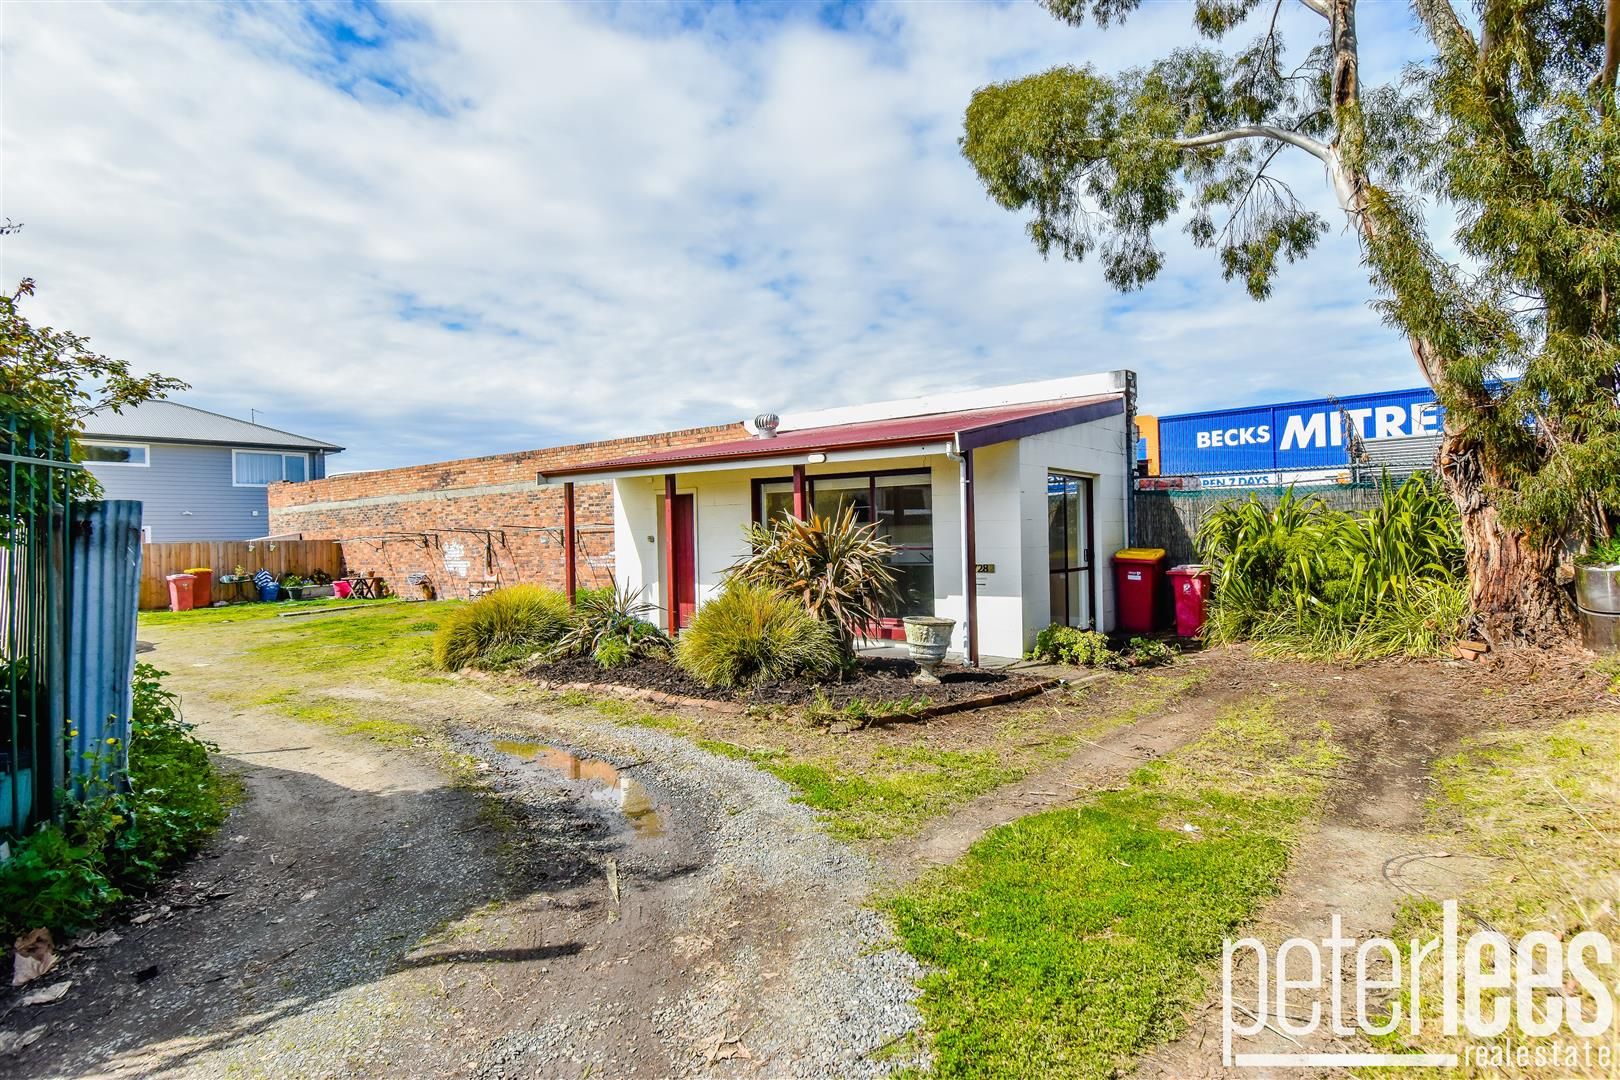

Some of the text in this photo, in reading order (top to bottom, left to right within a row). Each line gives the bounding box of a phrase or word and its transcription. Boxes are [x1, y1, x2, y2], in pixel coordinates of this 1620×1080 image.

[1196, 402, 1443, 450] BECKS MITRE
[1202, 475, 1270, 486] PEN 7 DAYS
